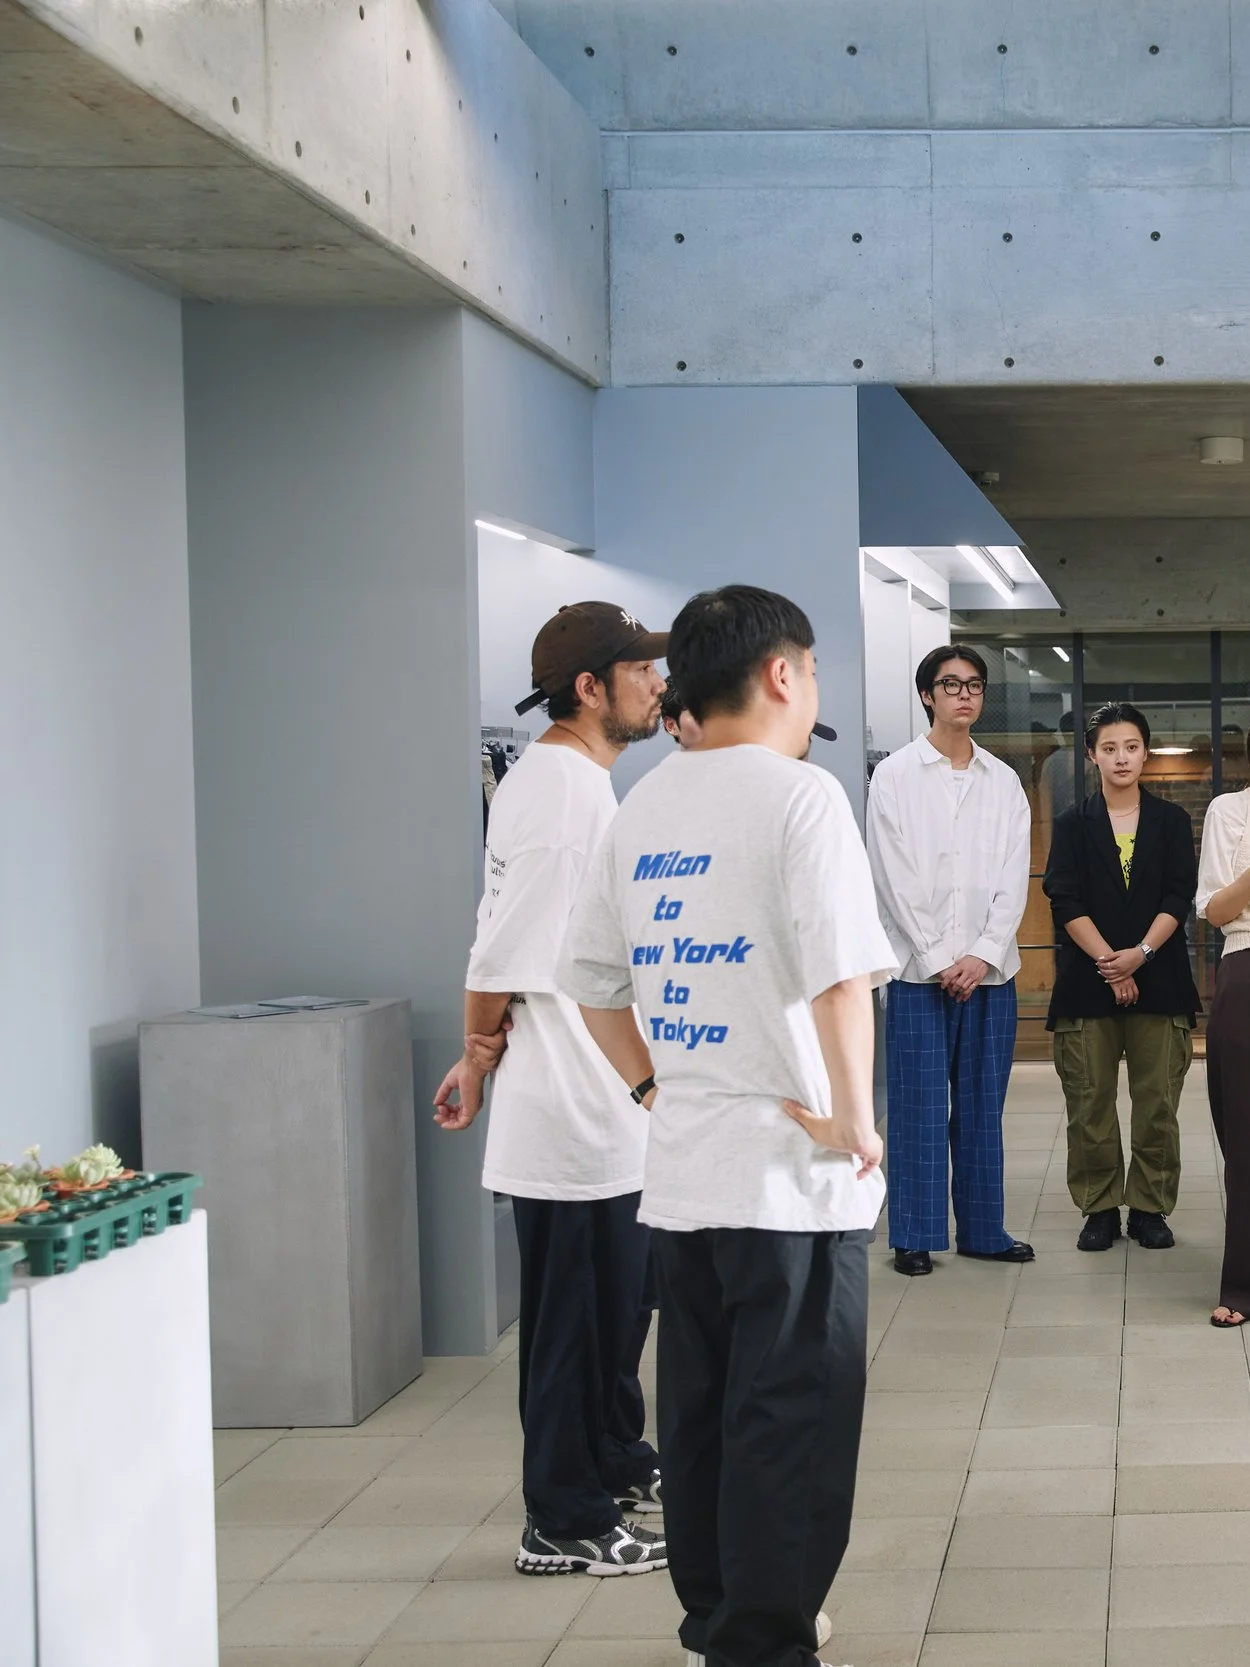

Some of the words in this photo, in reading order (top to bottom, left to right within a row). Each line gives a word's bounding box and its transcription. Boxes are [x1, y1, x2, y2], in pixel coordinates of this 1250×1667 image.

[633, 850, 712, 881] Milan
[653, 894, 683, 921] to
[631, 944, 665, 965] ew
[673, 936, 755, 963] York
[663, 979, 690, 1004] to
[650, 1016, 728, 1050] Tokyo
